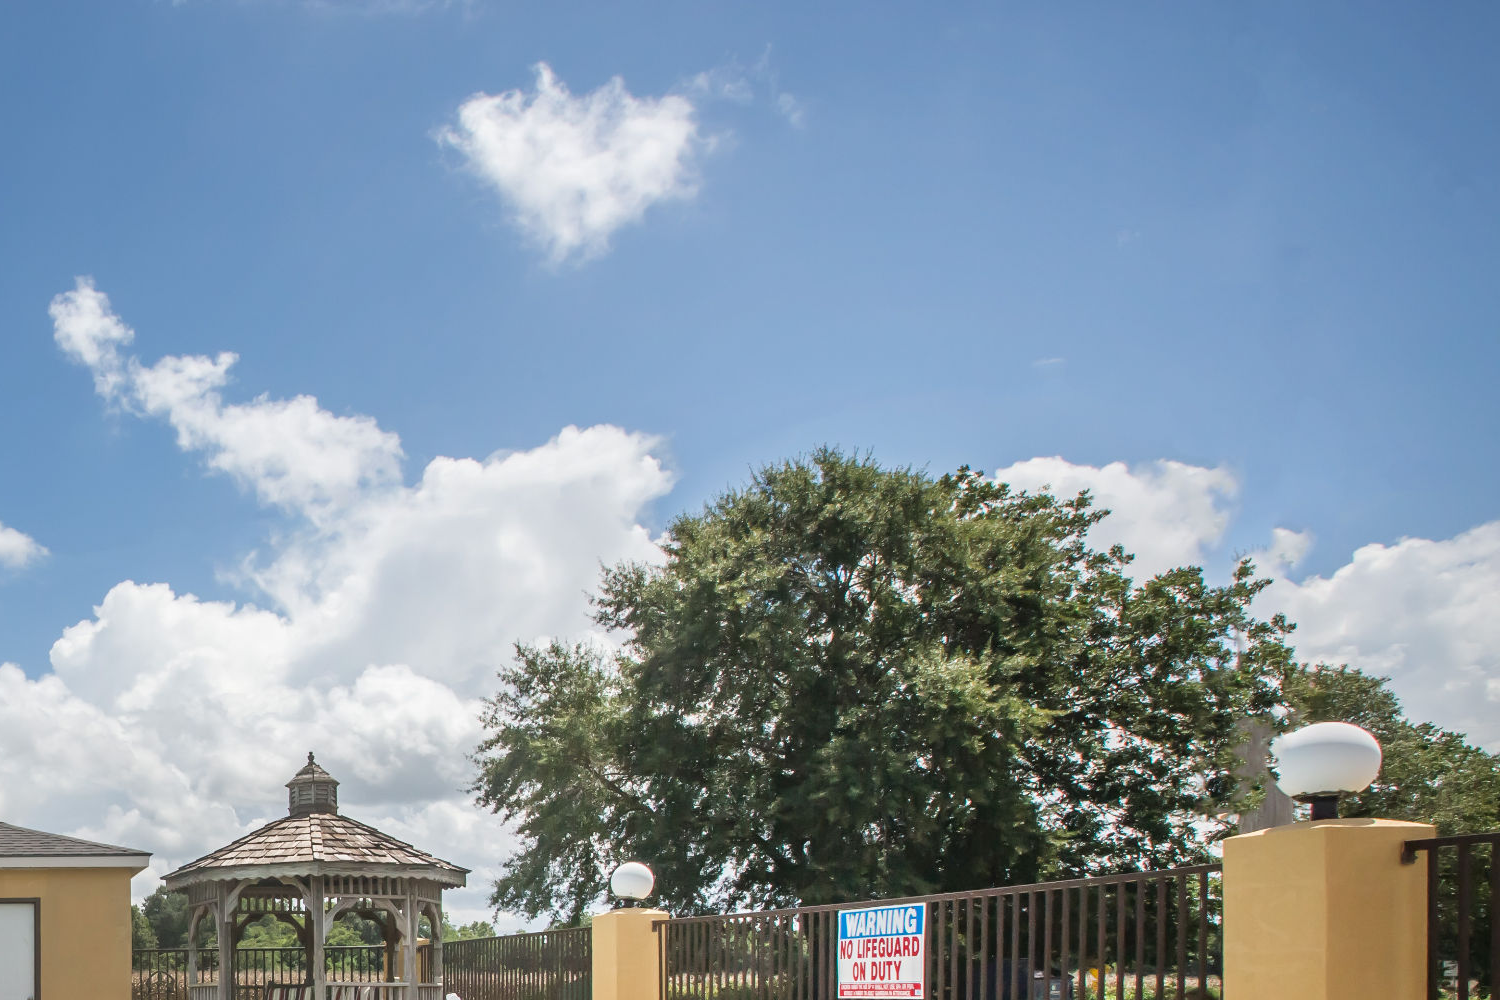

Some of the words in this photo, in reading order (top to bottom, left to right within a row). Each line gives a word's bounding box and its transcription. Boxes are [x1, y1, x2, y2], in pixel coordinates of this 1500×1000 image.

[846, 907, 917, 937] WARNING
[840, 940, 853, 959] NO
[857, 936, 919, 958] LIFEGUARD
[852, 961, 866, 981] ON
[870, 960, 902, 981] DUTY
